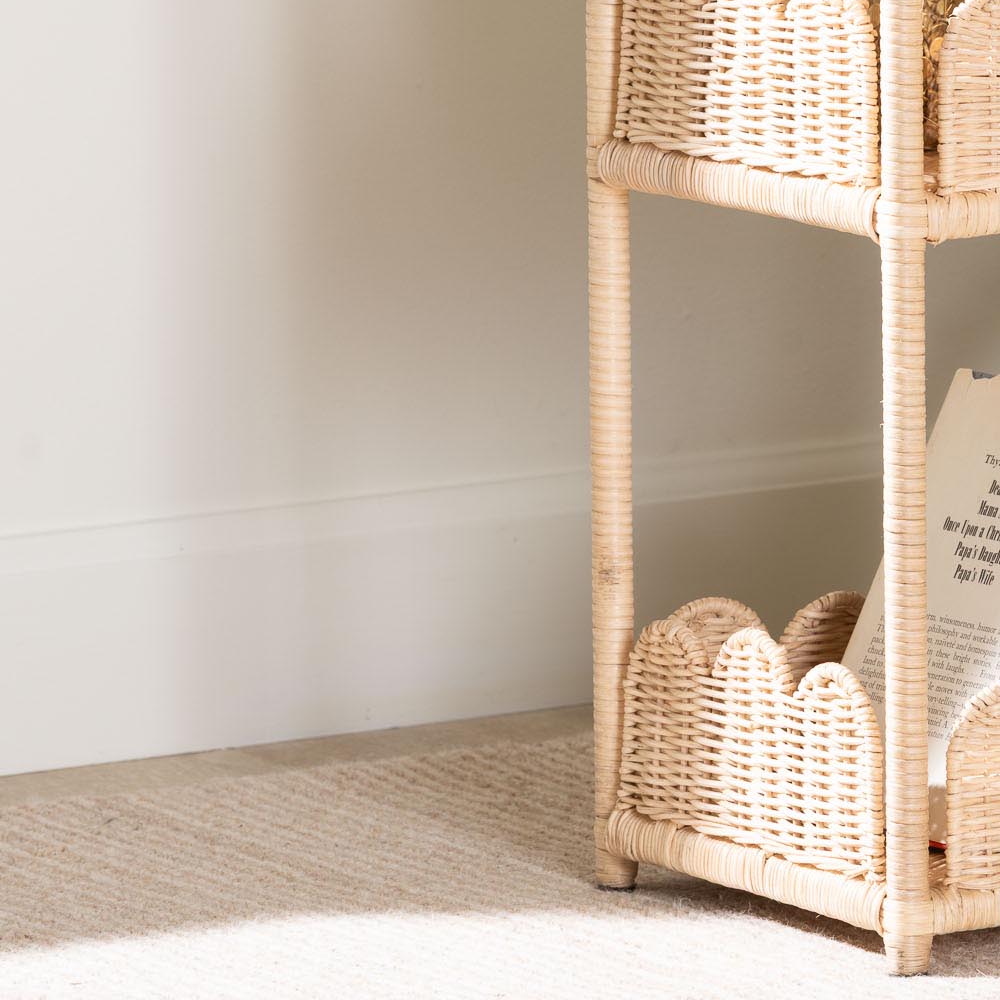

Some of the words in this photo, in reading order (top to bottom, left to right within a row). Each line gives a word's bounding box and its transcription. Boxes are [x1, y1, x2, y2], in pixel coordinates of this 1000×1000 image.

[943, 515, 961, 533] Once
[960, 519, 979, 538] Upon
[954, 541, 978, 561] Papa's
[953, 563, 978, 584] Papa's
[978, 568, 995, 586] Wife
